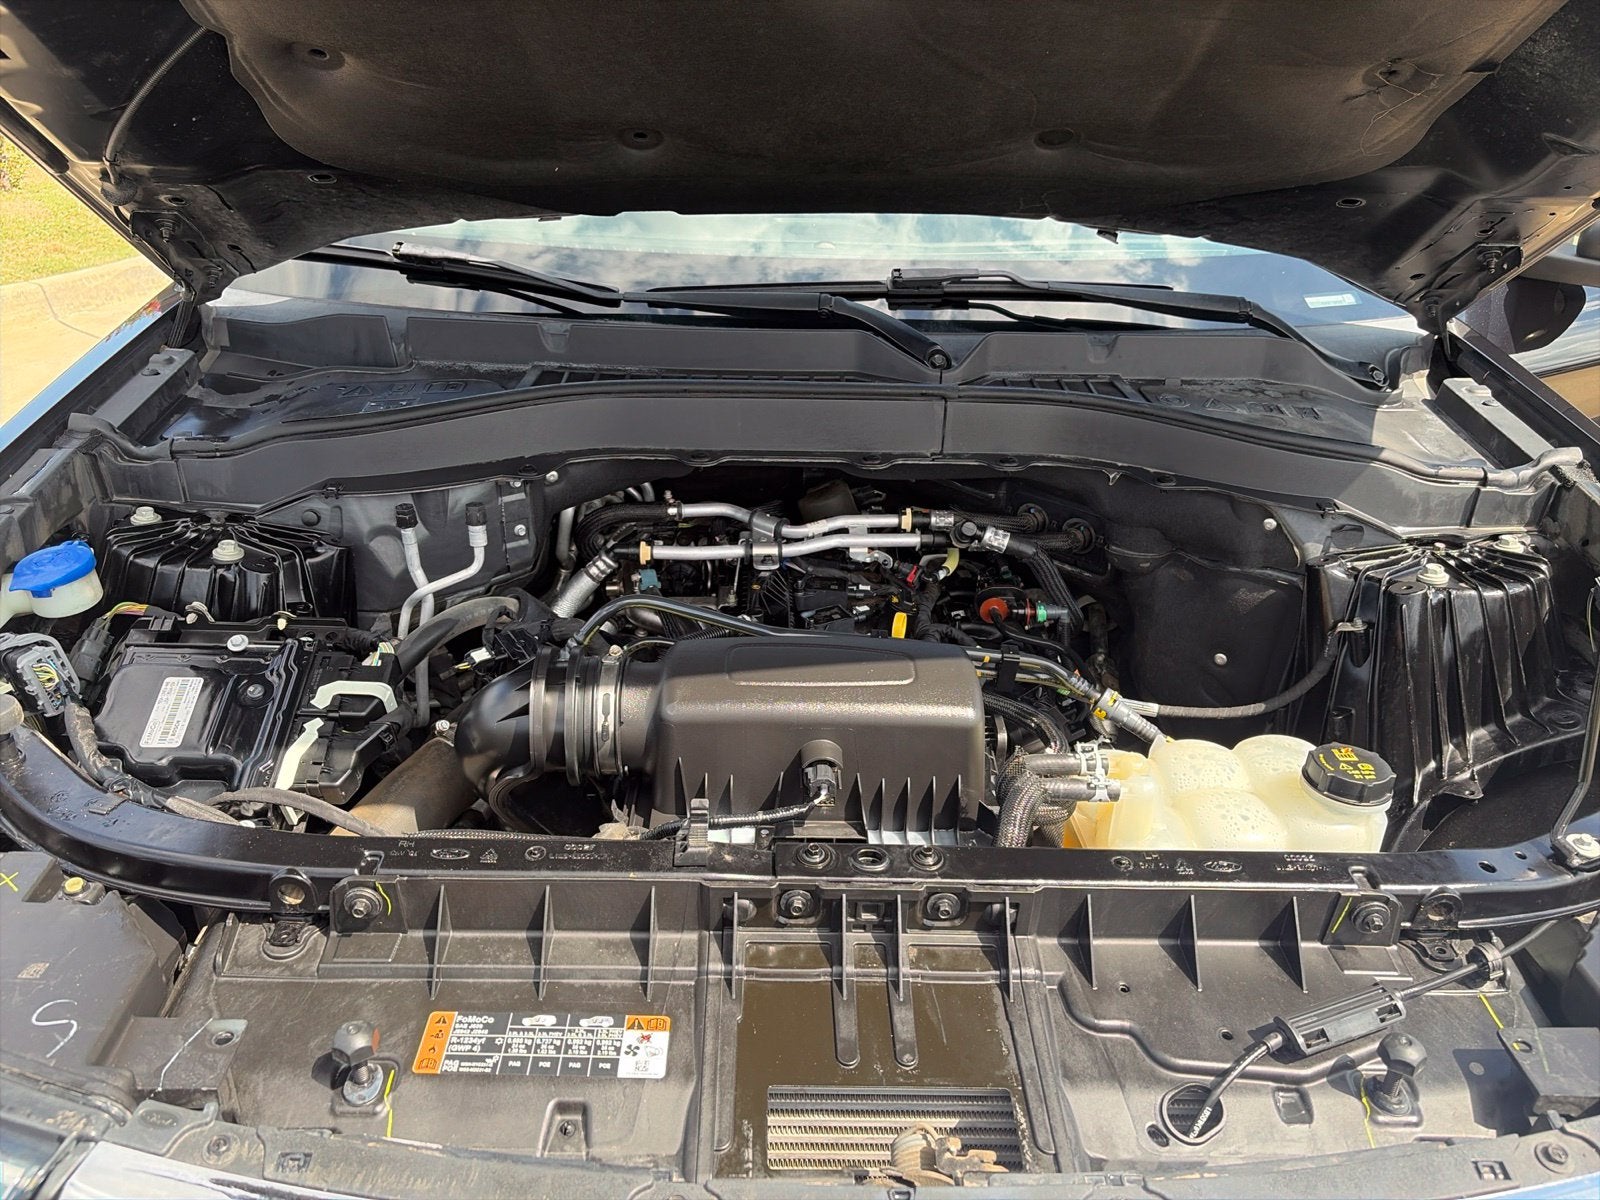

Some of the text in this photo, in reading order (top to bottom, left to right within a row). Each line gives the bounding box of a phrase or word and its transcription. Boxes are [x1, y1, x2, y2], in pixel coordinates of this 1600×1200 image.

[456, 1015, 495, 1024] FoMoCo
[450, 1037, 486, 1045] R-1234yf
[448, 1044, 481, 1054] (GWP 4)
